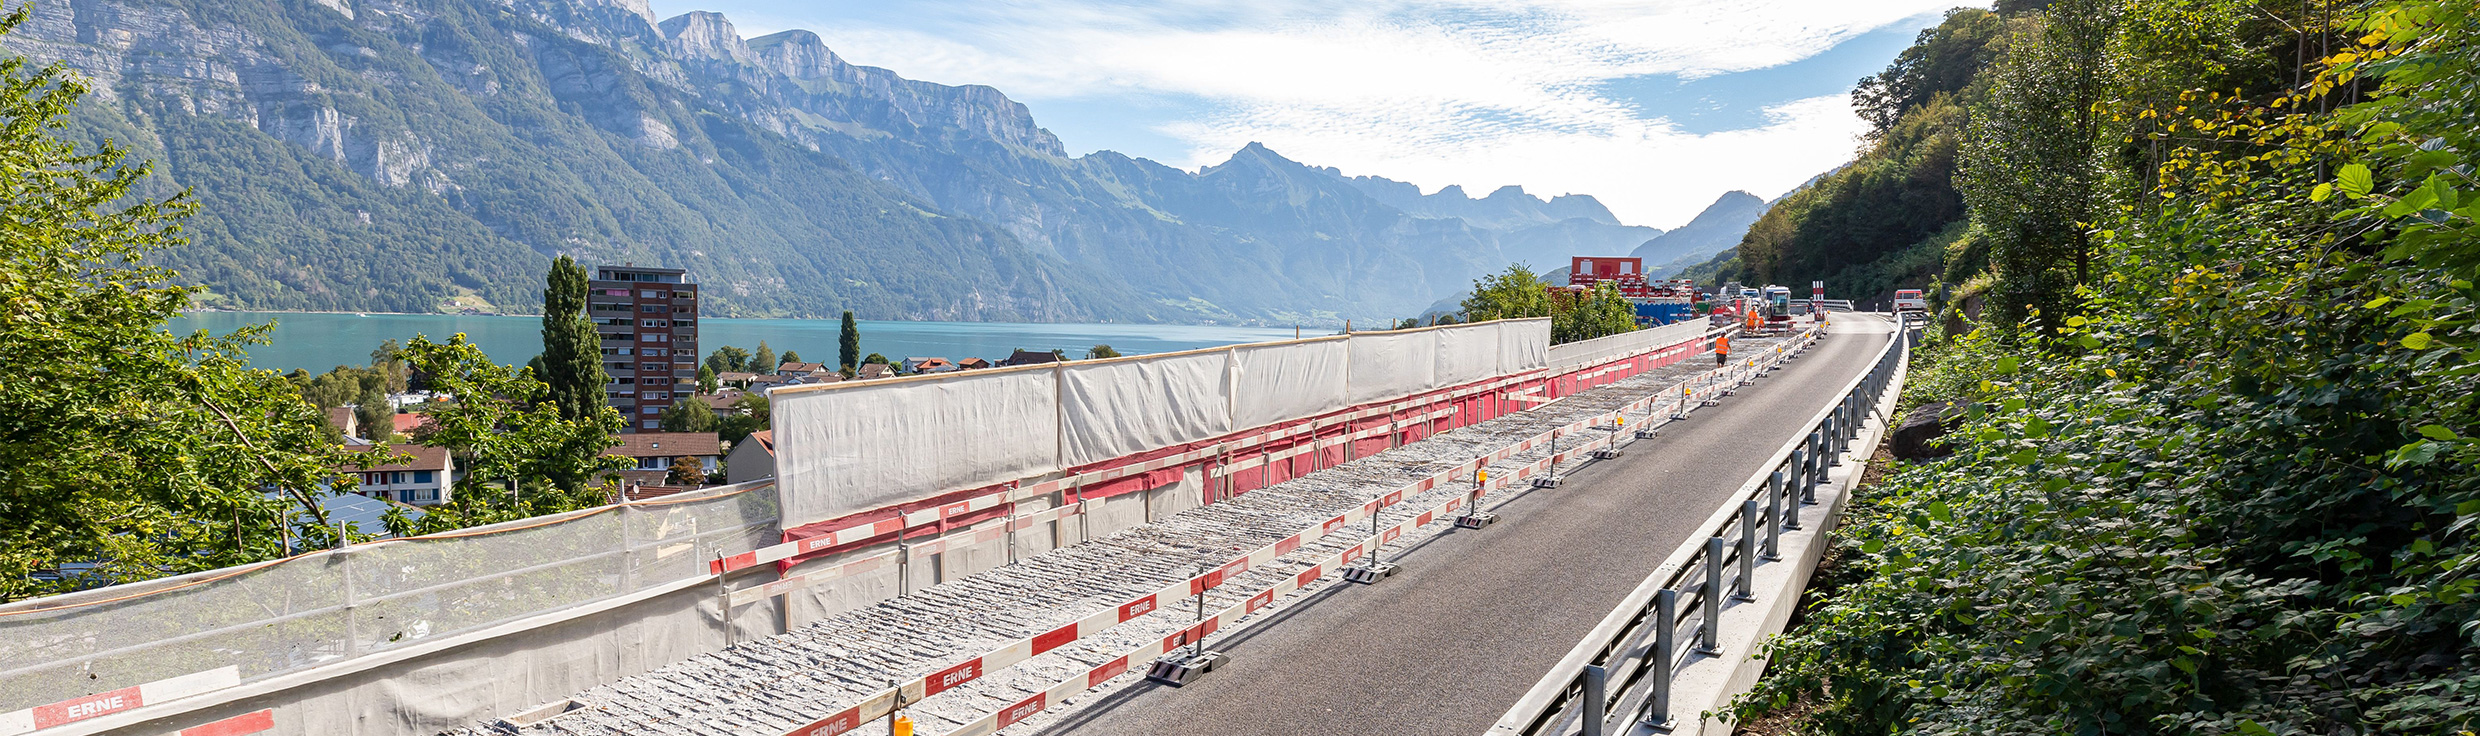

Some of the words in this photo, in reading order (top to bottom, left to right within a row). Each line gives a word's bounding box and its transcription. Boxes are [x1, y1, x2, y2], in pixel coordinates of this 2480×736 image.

[948, 505, 965, 515] ERNE
[811, 537, 831, 549] ERNE
[1228, 562, 1244, 575] ERNE
[1130, 599, 1150, 616] ERNE
[1254, 595, 1268, 609] ERNE
[943, 666, 973, 687] ERNE
[67, 696, 124, 718] ERNE
[1012, 700, 1038, 720] ERNE
